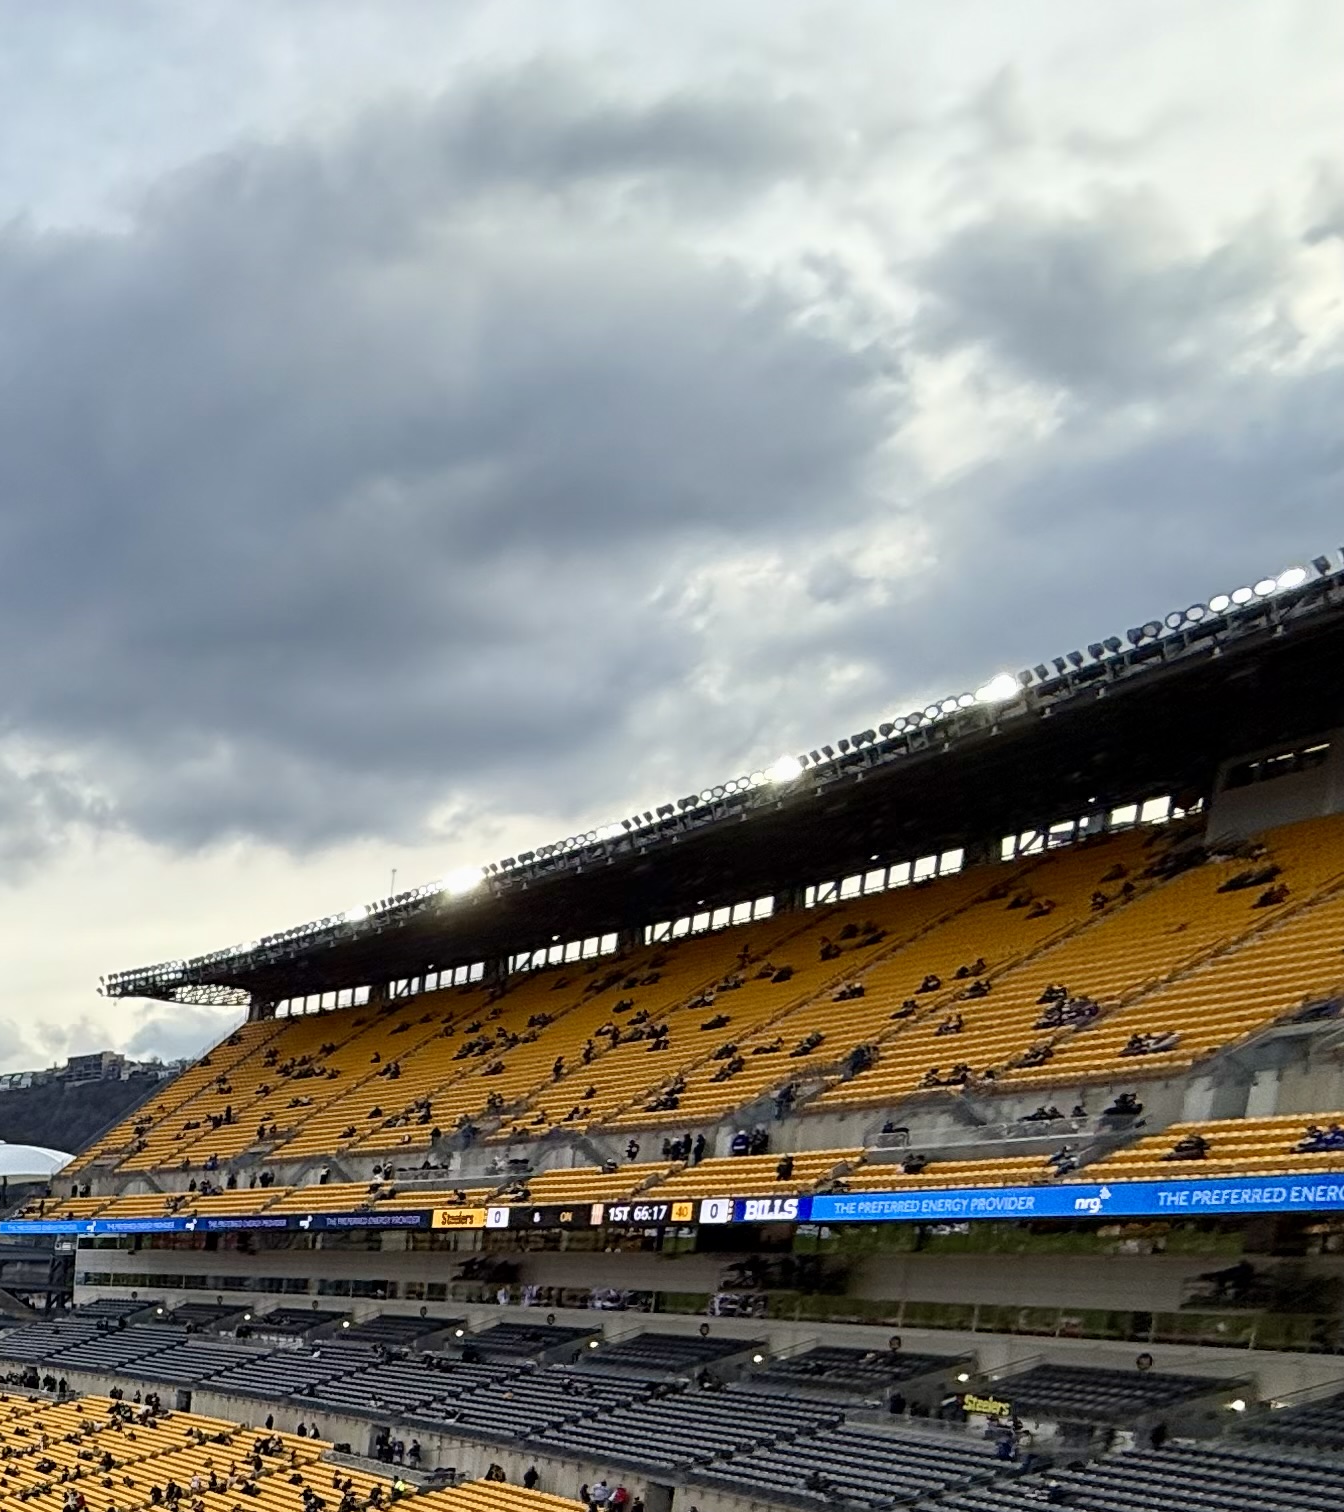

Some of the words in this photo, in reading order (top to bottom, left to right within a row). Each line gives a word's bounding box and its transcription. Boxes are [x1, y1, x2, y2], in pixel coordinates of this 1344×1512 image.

[834, 1202, 856, 1214] THE
[857, 1200, 920, 1213] PREFERRED
[922, 1198, 968, 1213] ENERGY
[970, 1196, 1035, 1211] PROVIDER
[1158, 1191, 1189, 1206] THE
[1191, 1187, 1286, 1205] PREFERRED
[494, 1211, 502, 1224] 0
[609, 1207, 629, 1221] 1ST
[710, 1203, 718, 1218] 0
[744, 1199, 798, 1221] BILLS
[962, 1394, 1010, 1416] Steelers
